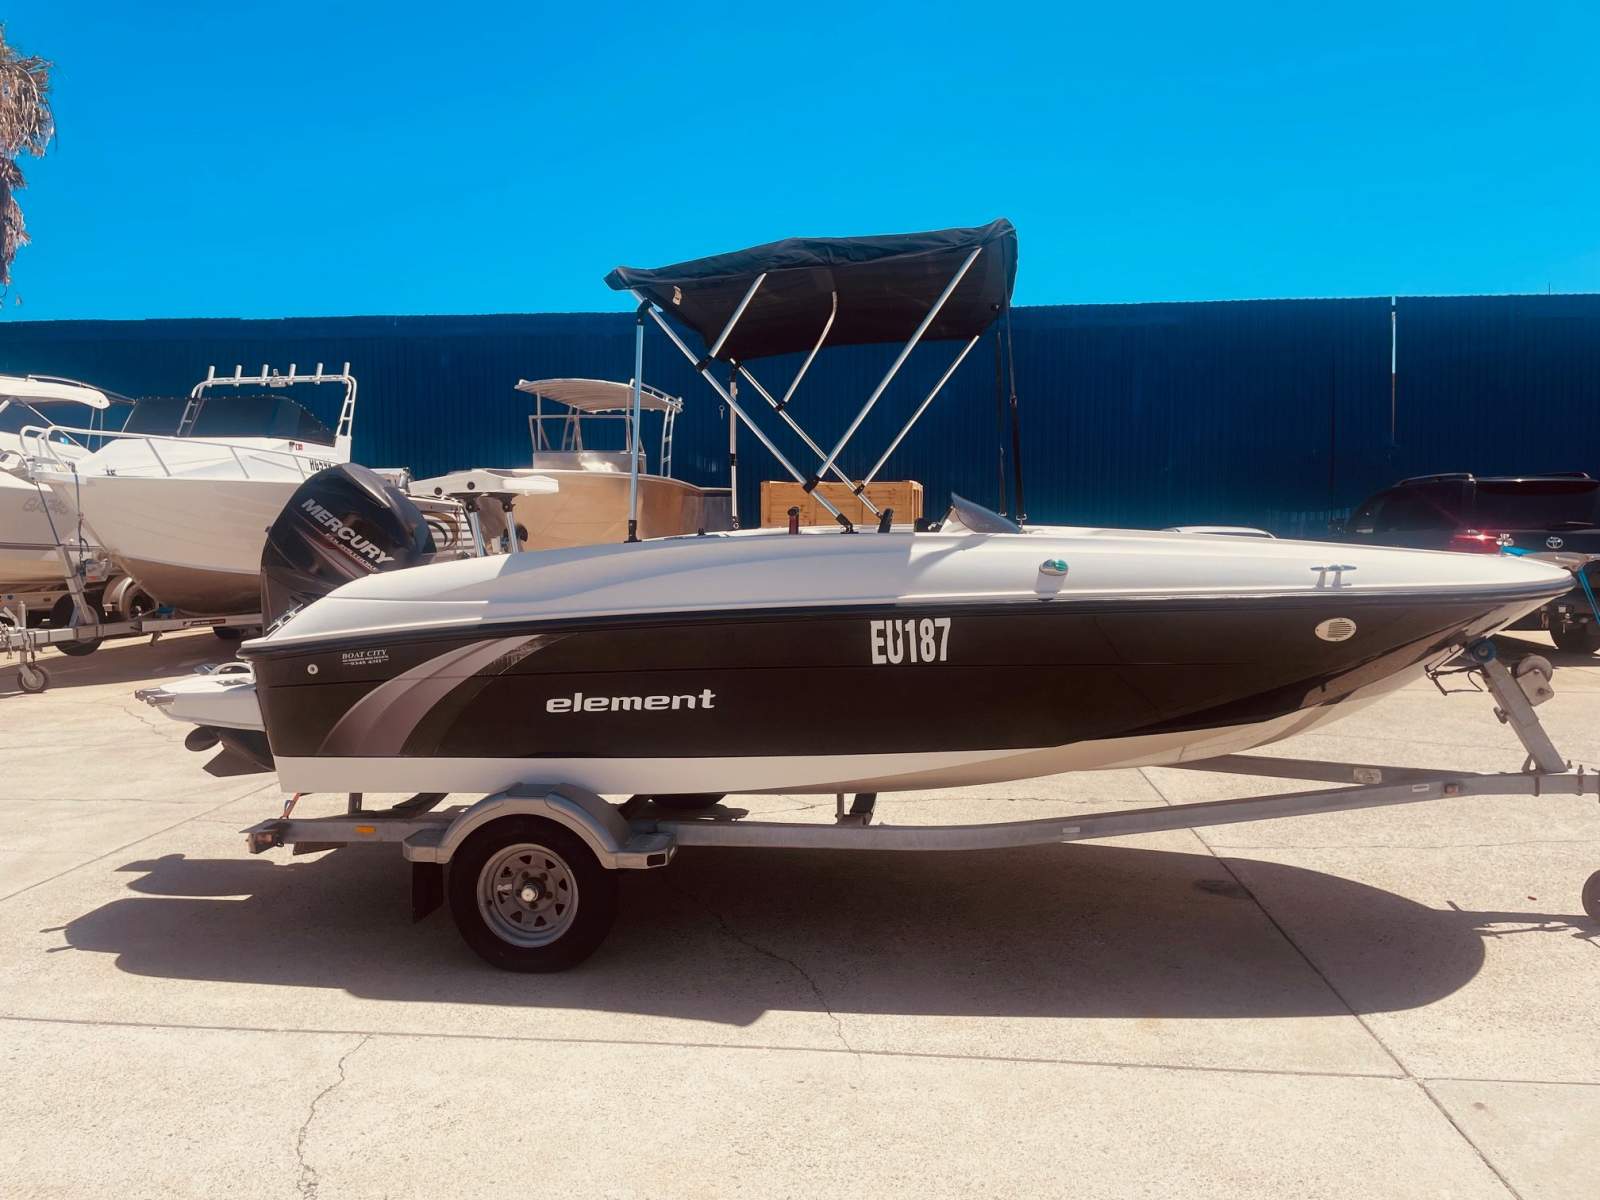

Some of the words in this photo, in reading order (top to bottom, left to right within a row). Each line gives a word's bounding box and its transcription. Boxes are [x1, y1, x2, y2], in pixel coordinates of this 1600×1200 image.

[301, 498, 395, 564] MERCURY
[342, 651, 365, 659] BOAT
[366, 649, 387, 657] CITY
[870, 617, 951, 664] EU187
[546, 689, 716, 713] element
